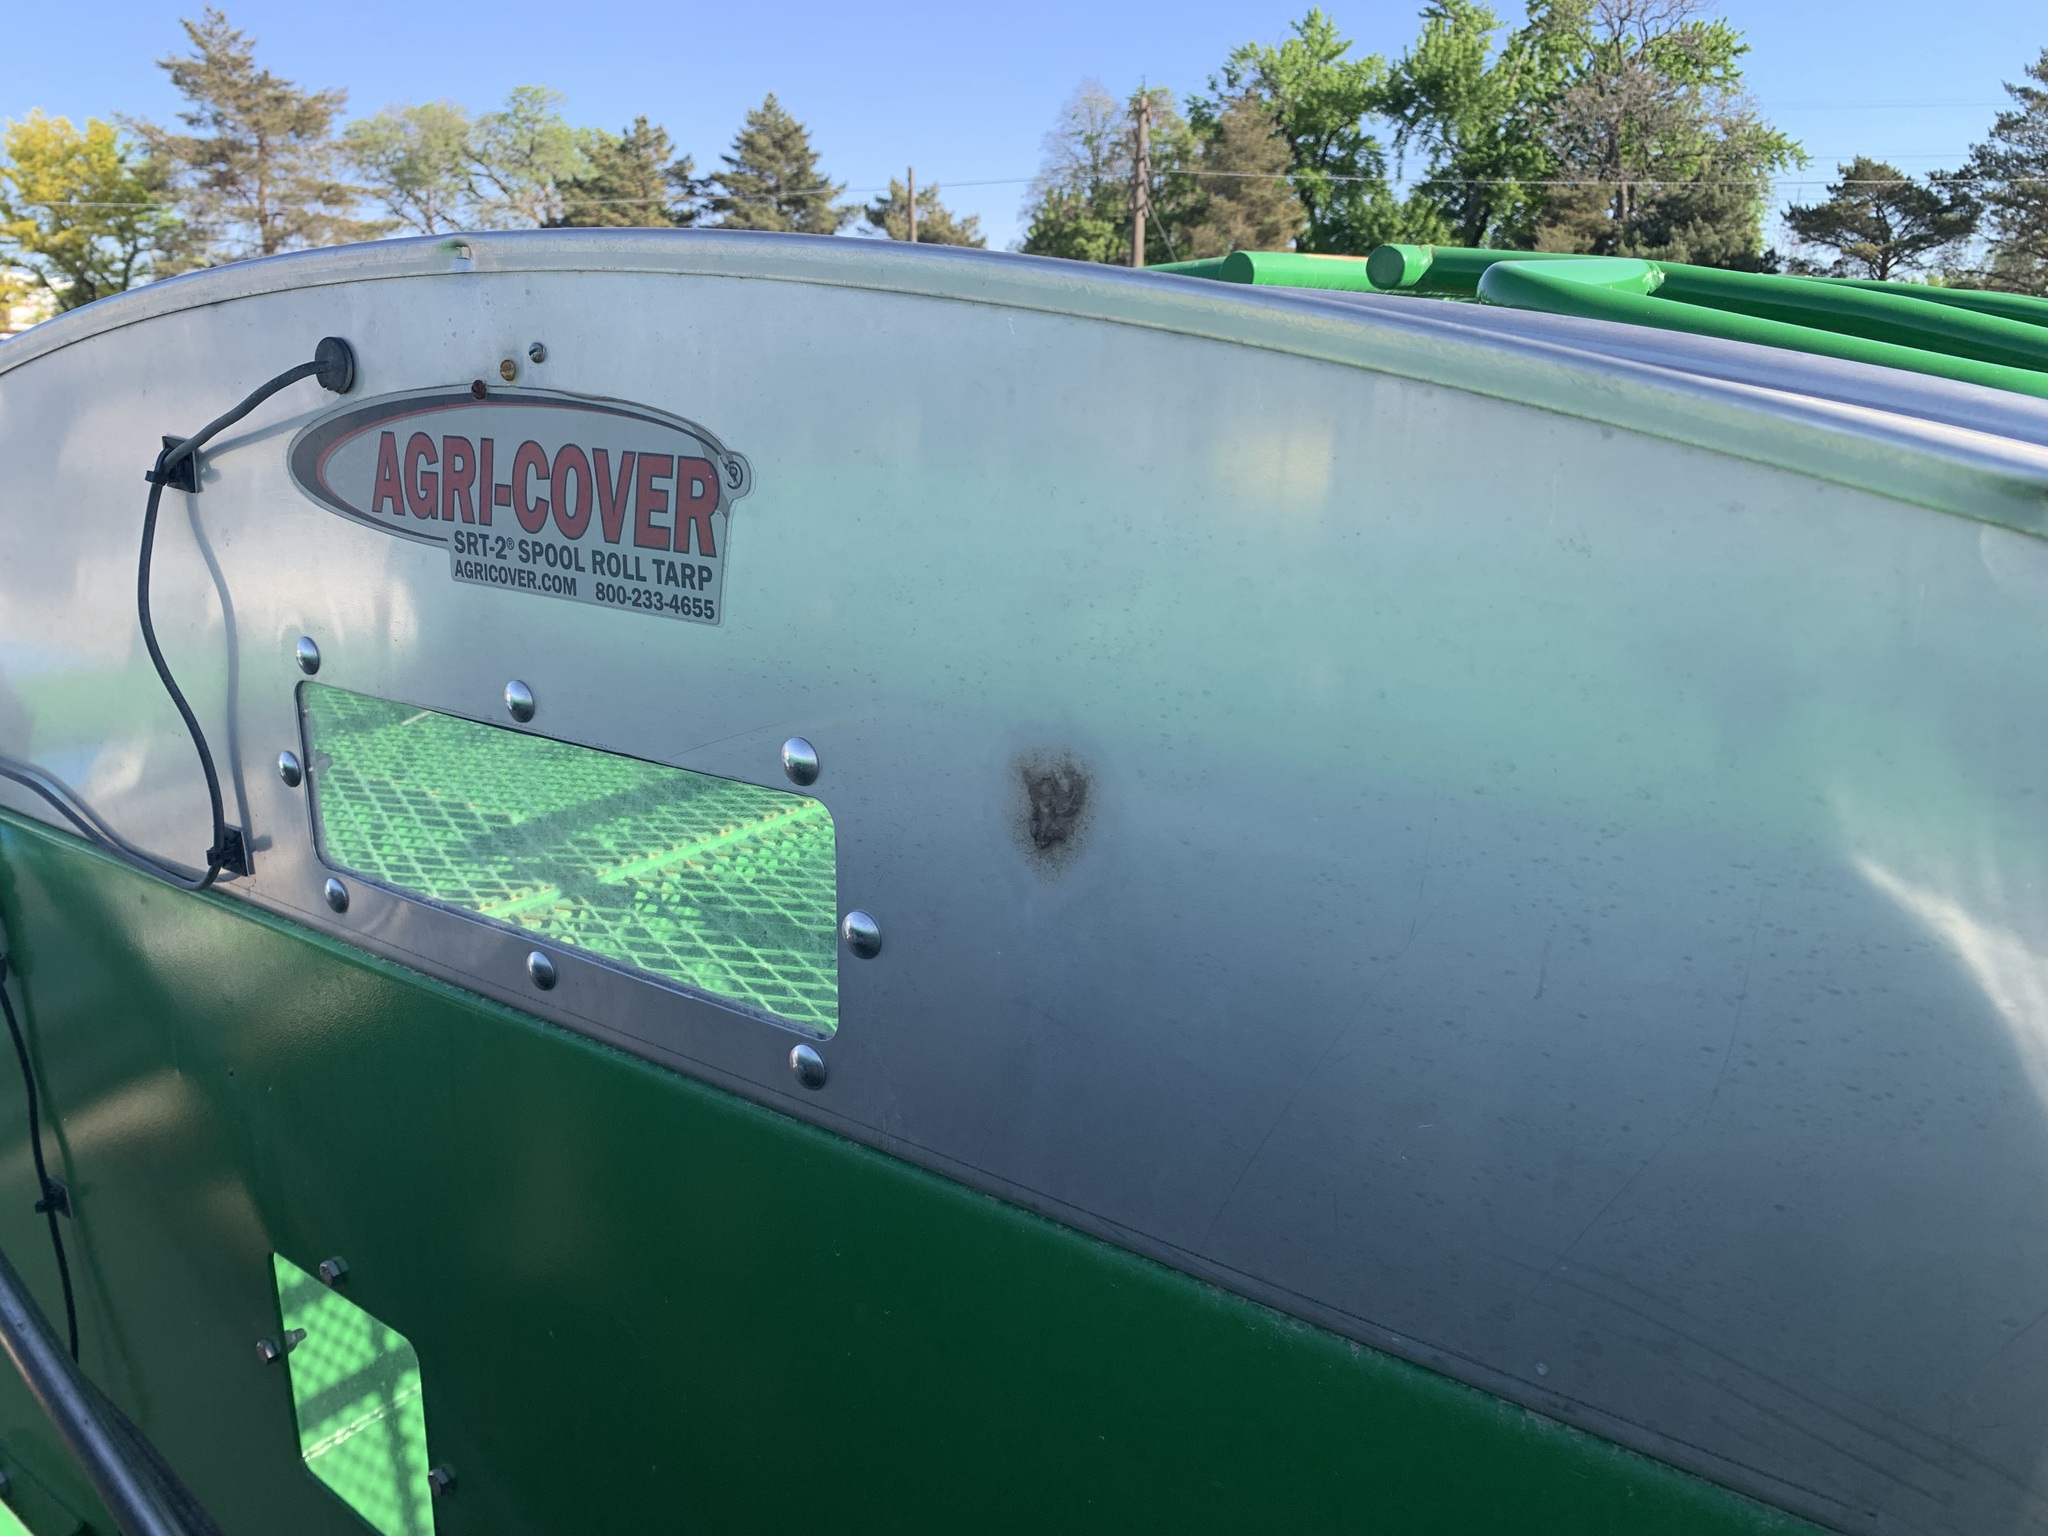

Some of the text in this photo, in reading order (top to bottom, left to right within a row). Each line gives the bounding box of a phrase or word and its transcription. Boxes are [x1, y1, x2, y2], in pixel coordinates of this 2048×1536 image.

[371, 430, 720, 558] AGRI-COVER
[454, 560, 715, 619] AGRICOVER.COM 800-233-4655
[518, 541, 586, 573] SPOOL
[592, 550, 647, 583] ROLL
[652, 559, 713, 591] TARP
